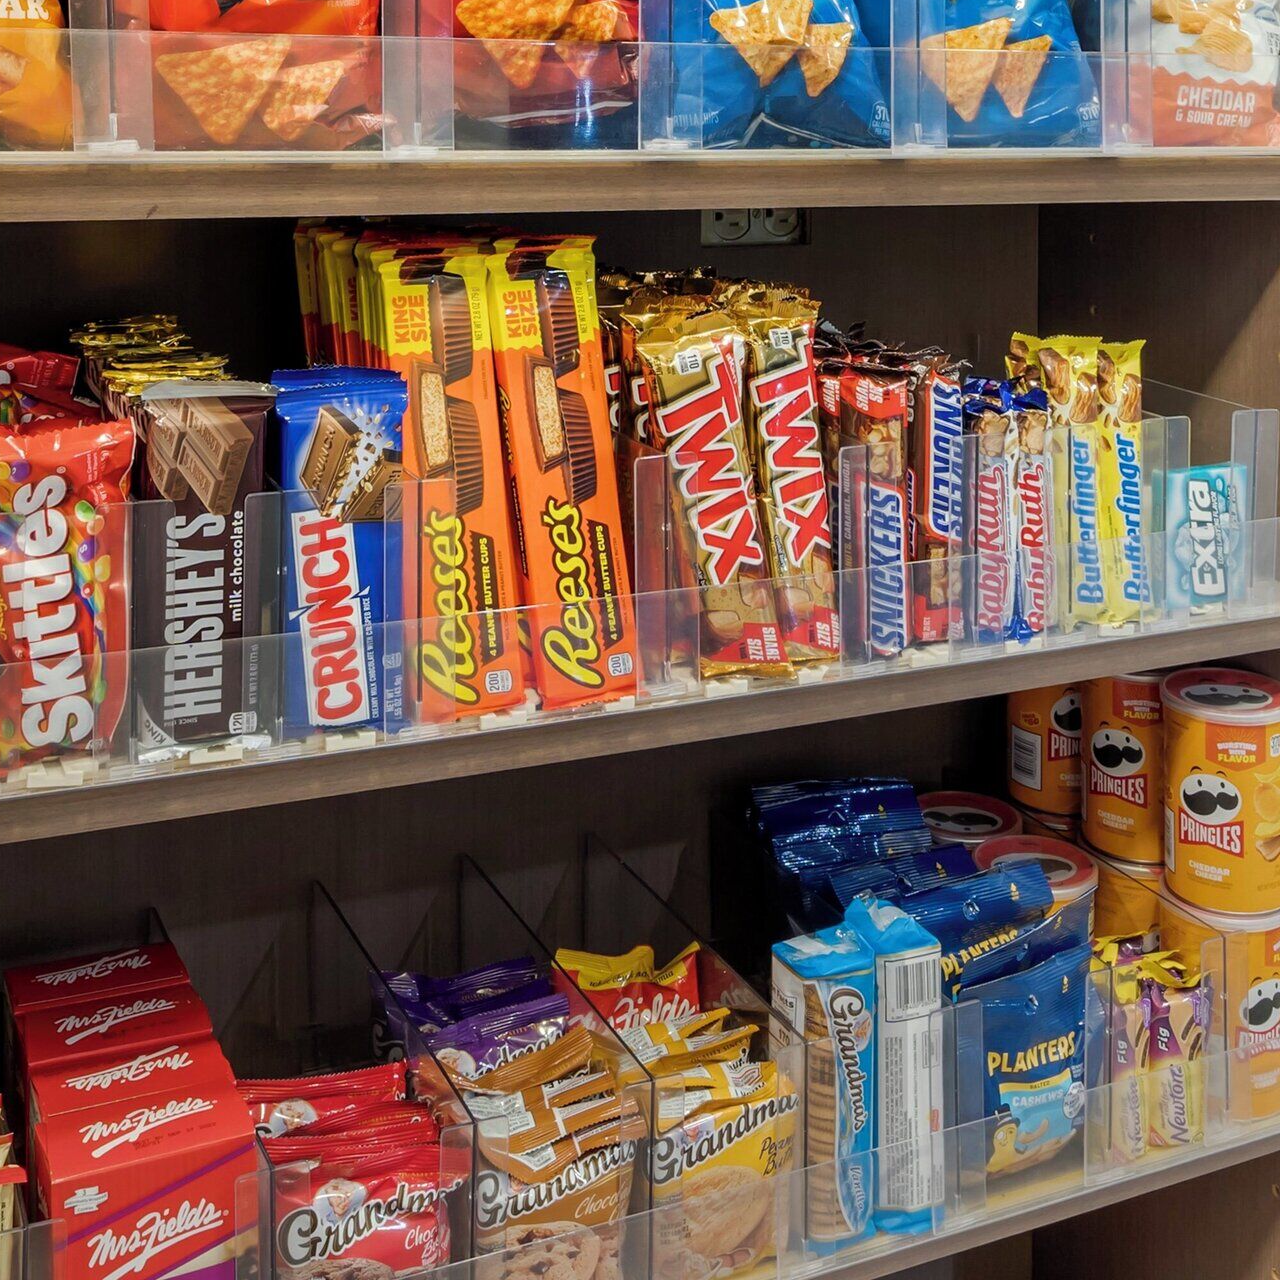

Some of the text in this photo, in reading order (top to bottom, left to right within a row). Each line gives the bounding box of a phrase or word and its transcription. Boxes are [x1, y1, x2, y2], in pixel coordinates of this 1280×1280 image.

[1174, 110, 1253, 128] & SOUR CREAM
[1175, 84, 1257, 115] CHEDDAR
[391, 294, 409, 343] KING
[409, 295, 426, 343] SIZE
[505, 290, 523, 339] KING
[521, 288, 538, 338] SIZE
[654, 360, 764, 587] TWIX
[747, 335, 832, 568] TWIX
[1019, 462, 1048, 549] Ruth
[1070, 435, 1105, 606] Butterfinger
[1116, 431, 1152, 606] Butterfinger
[1187, 478, 1227, 597] Extra
[230, 509, 244, 586] chocolate
[869, 488, 907, 653] SNICKERS
[9, 474, 96, 750] Skittles
[162, 511, 227, 718] HERSHEY'S
[231, 587, 243, 622] milk
[302, 518, 366, 723] CRUNCH
[420, 508, 480, 706] Reese's
[541, 495, 606, 690] Reese's
[1025, 546, 1055, 634] Baby
[1090, 769, 1146, 806] PRINGLES
[1216, 751, 1257, 765] FLAVOR
[1179, 813, 1244, 856] PRINGLES
[986, 1030, 1077, 1077] PLANTERS
[1011, 1087, 1066, 1110] CASHEWS
[1170, 1064, 1190, 1144] Newtons
[849, 1165, 865, 1213] Vanilla
